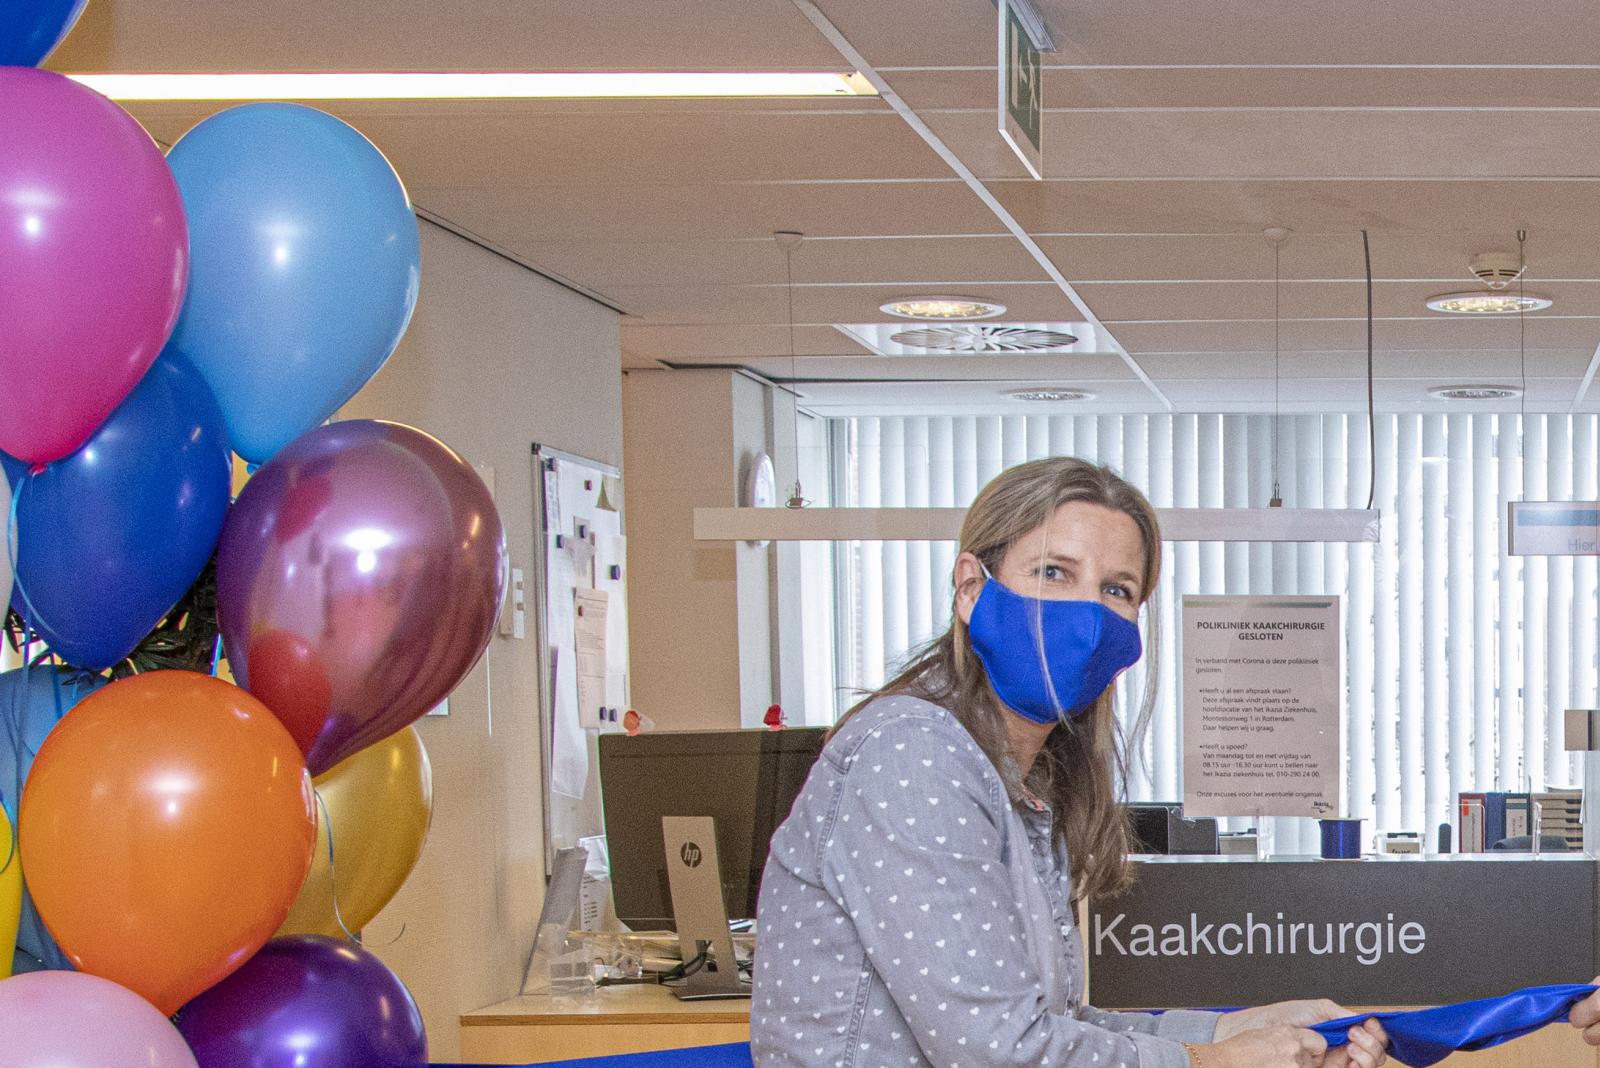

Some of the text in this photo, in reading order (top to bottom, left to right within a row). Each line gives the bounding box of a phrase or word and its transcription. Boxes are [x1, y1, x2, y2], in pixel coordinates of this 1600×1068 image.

[1568, 539, 1593, 551] Hier
[1197, 621, 1325, 630] POLIKLINIEK KAAKCHIRURGIE
[1288, 658, 1318, 666] polikliniek
[682, 841, 701, 867] hp
[1094, 912, 1426, 965] Kaakchirurgie
